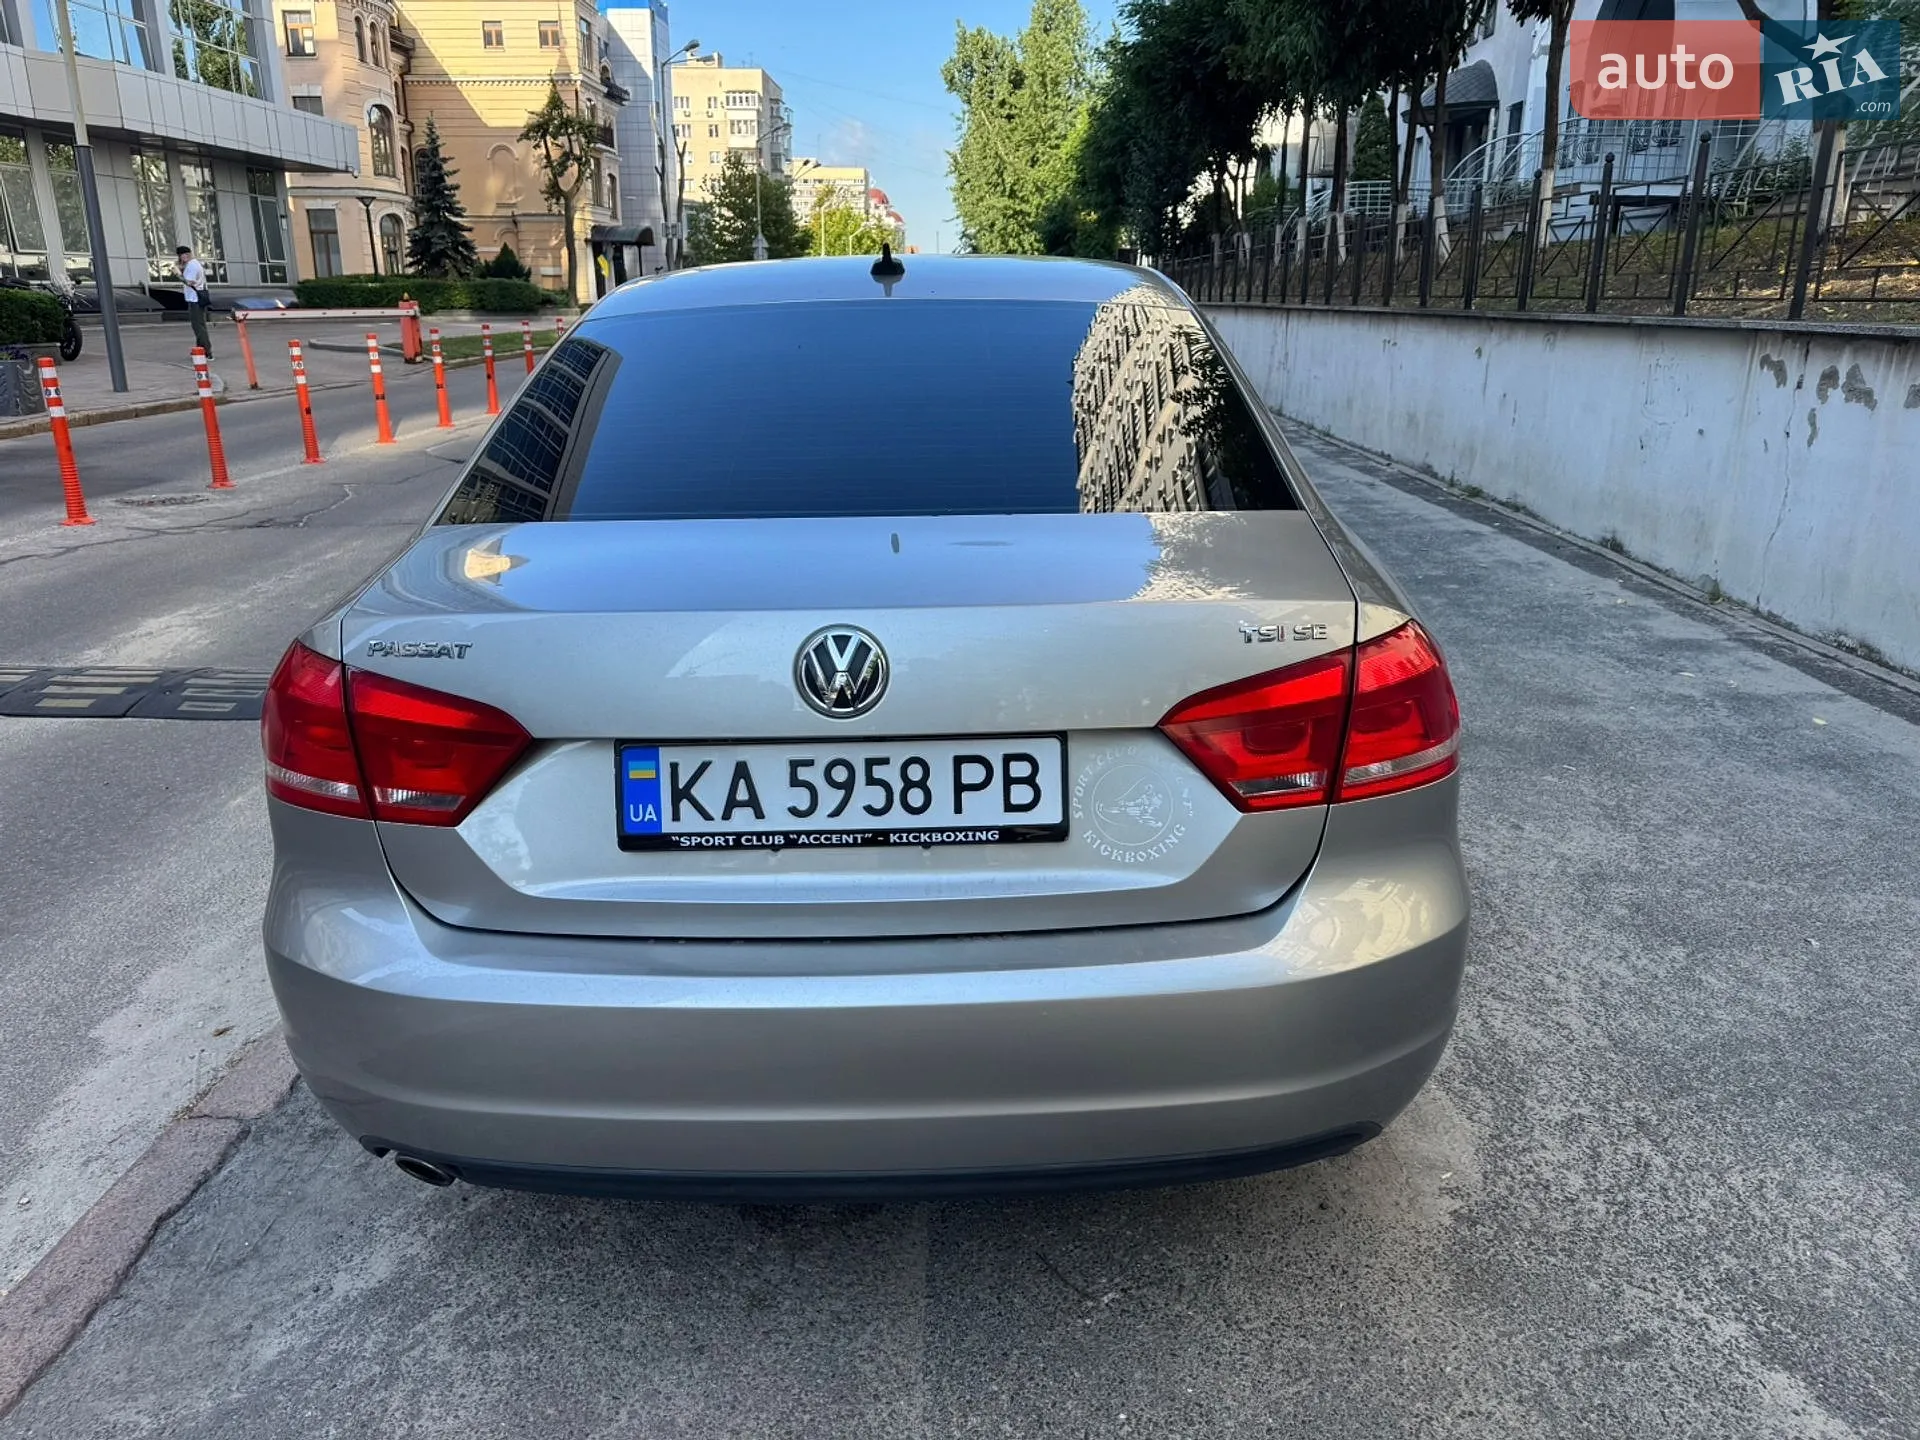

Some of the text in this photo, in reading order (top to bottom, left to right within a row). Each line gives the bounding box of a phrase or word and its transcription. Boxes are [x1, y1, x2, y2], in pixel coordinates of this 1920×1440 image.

[1239, 623, 1328, 644] TSI SE
[366, 639, 474, 659] PASSAT
[800, 629, 884, 713] VW
[669, 752, 1042, 822] KA 5958 PB
[630, 804, 658, 822] UA
[741, 834, 785, 846] CLUB
[889, 830, 1000, 843] KICKBOXING
